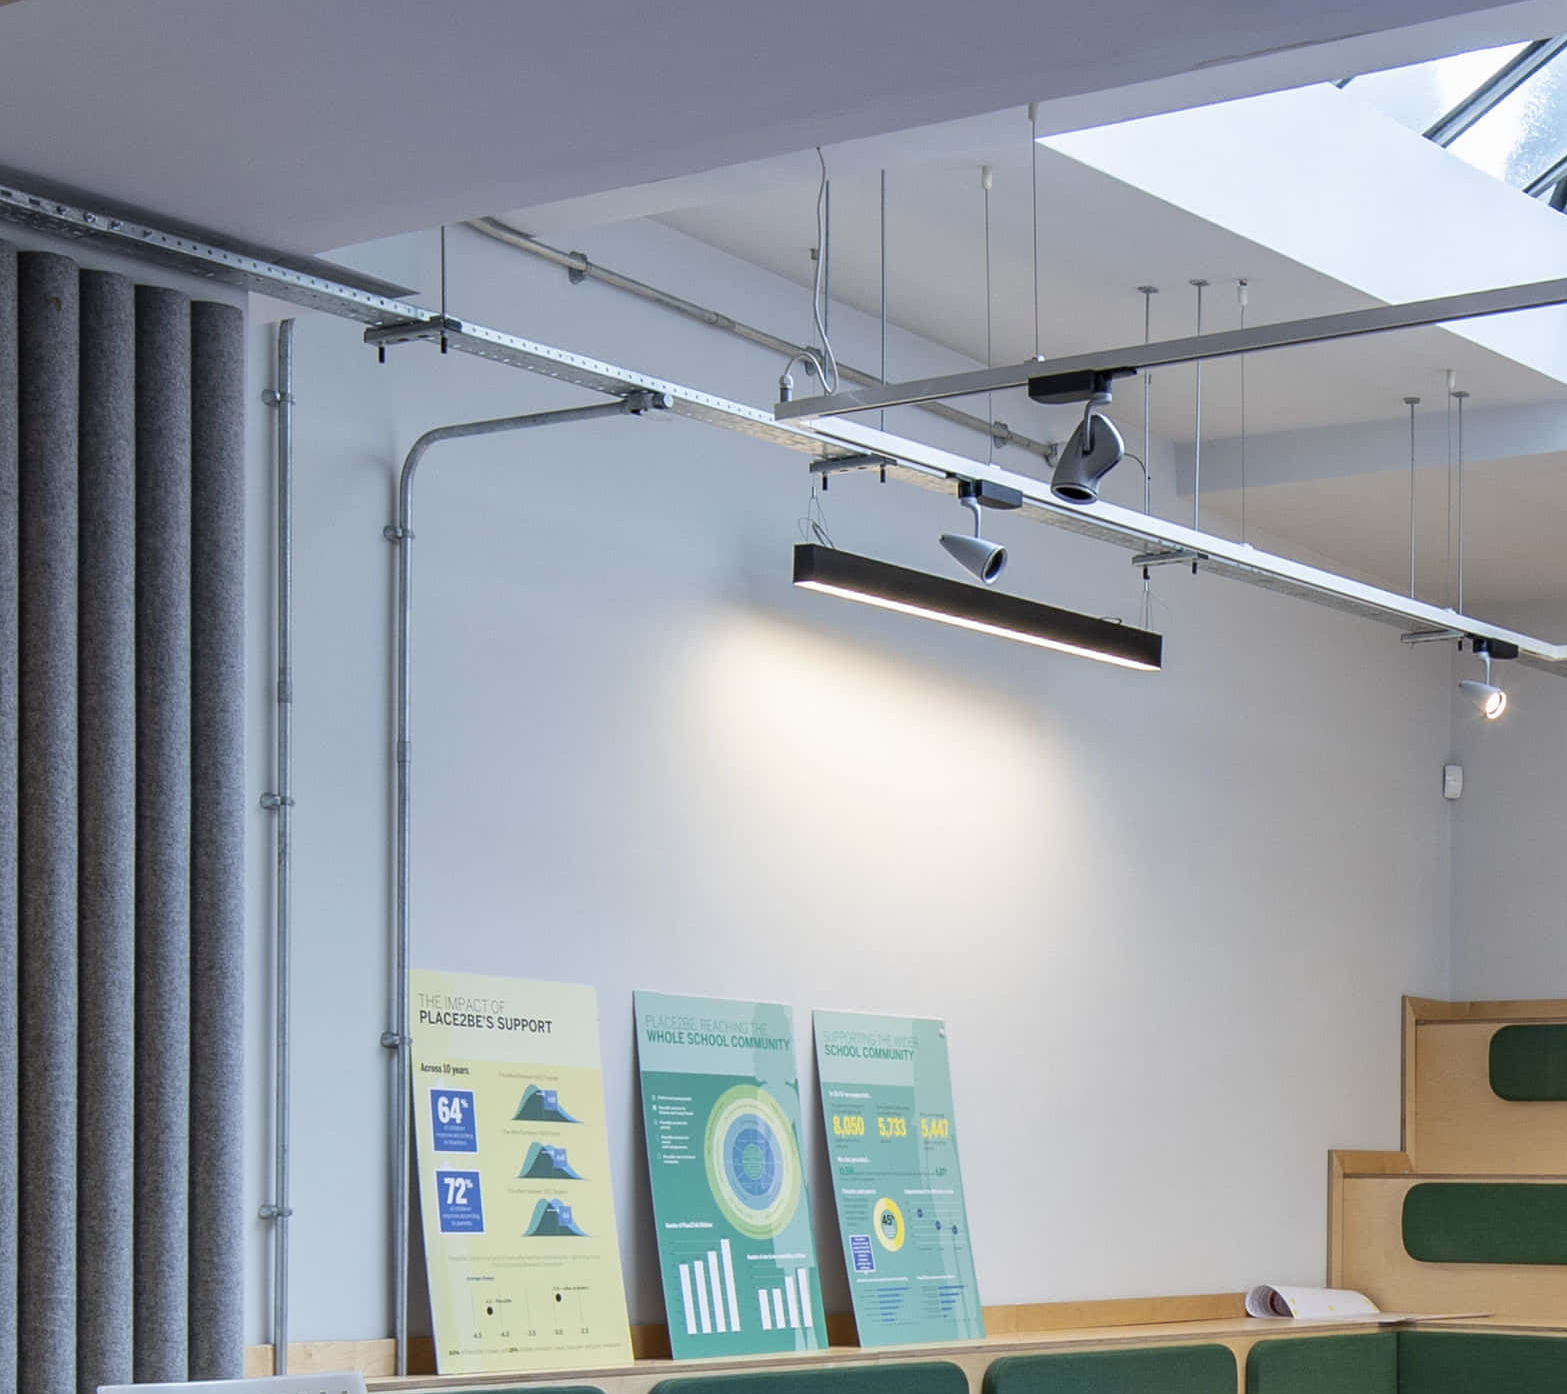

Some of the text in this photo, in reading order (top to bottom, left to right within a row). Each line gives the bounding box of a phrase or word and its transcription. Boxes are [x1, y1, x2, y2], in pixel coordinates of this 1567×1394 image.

[418, 993, 505, 1014] THE IMPACT OF
[419, 1010, 553, 1033] PLACE2BE'S SUPPORT
[751, 1022, 768, 1035] THE
[647, 1030, 791, 1050] WHOLE SCHOOL COMMUNITY
[824, 1044, 915, 1061] SCHOOL COMMUNITY
[421, 1062, 442, 1073] Across
[443, 1063, 451, 1074] 10
[437, 1096, 469, 1124] 64%
[443, 1177, 473, 1205] 72%
